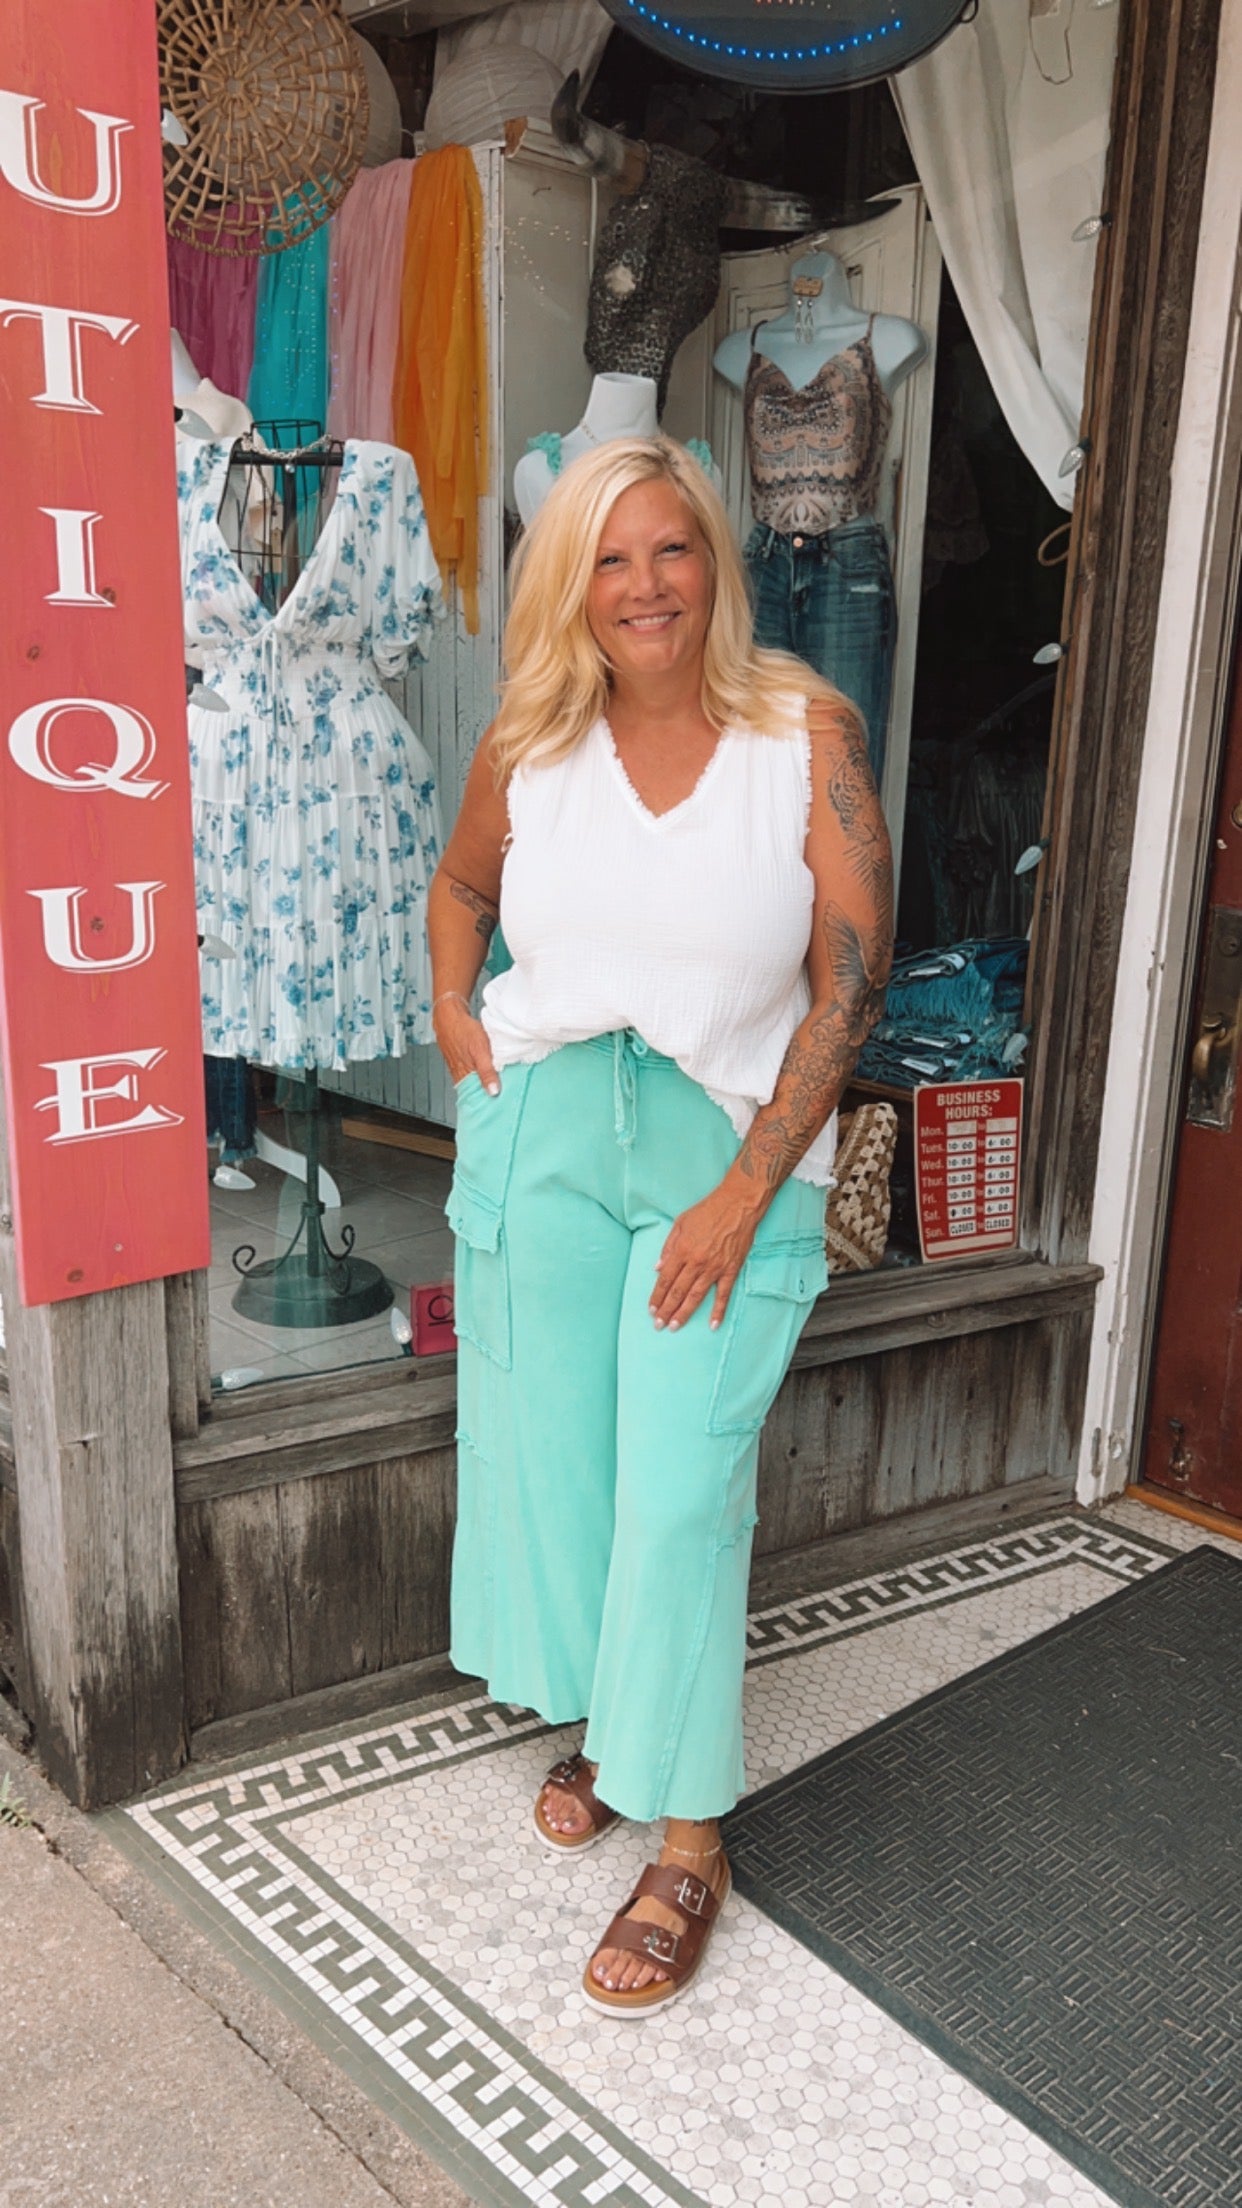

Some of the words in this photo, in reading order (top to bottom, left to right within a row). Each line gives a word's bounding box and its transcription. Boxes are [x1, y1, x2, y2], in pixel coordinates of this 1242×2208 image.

[937, 1089, 1000, 1107] BUSINESS
[945, 1104, 992, 1120] HOURS:
[921, 1126, 944, 1137] Mon.
[921, 1143, 945, 1154] Tues.
[921, 1159, 944, 1171] Wed.
[922, 1193, 937, 1205] Fri.
[923, 1209, 941, 1222] Sat.
[925, 1228, 945, 1240] Sun.
[986, 1218, 1010, 1229] CLOSED
